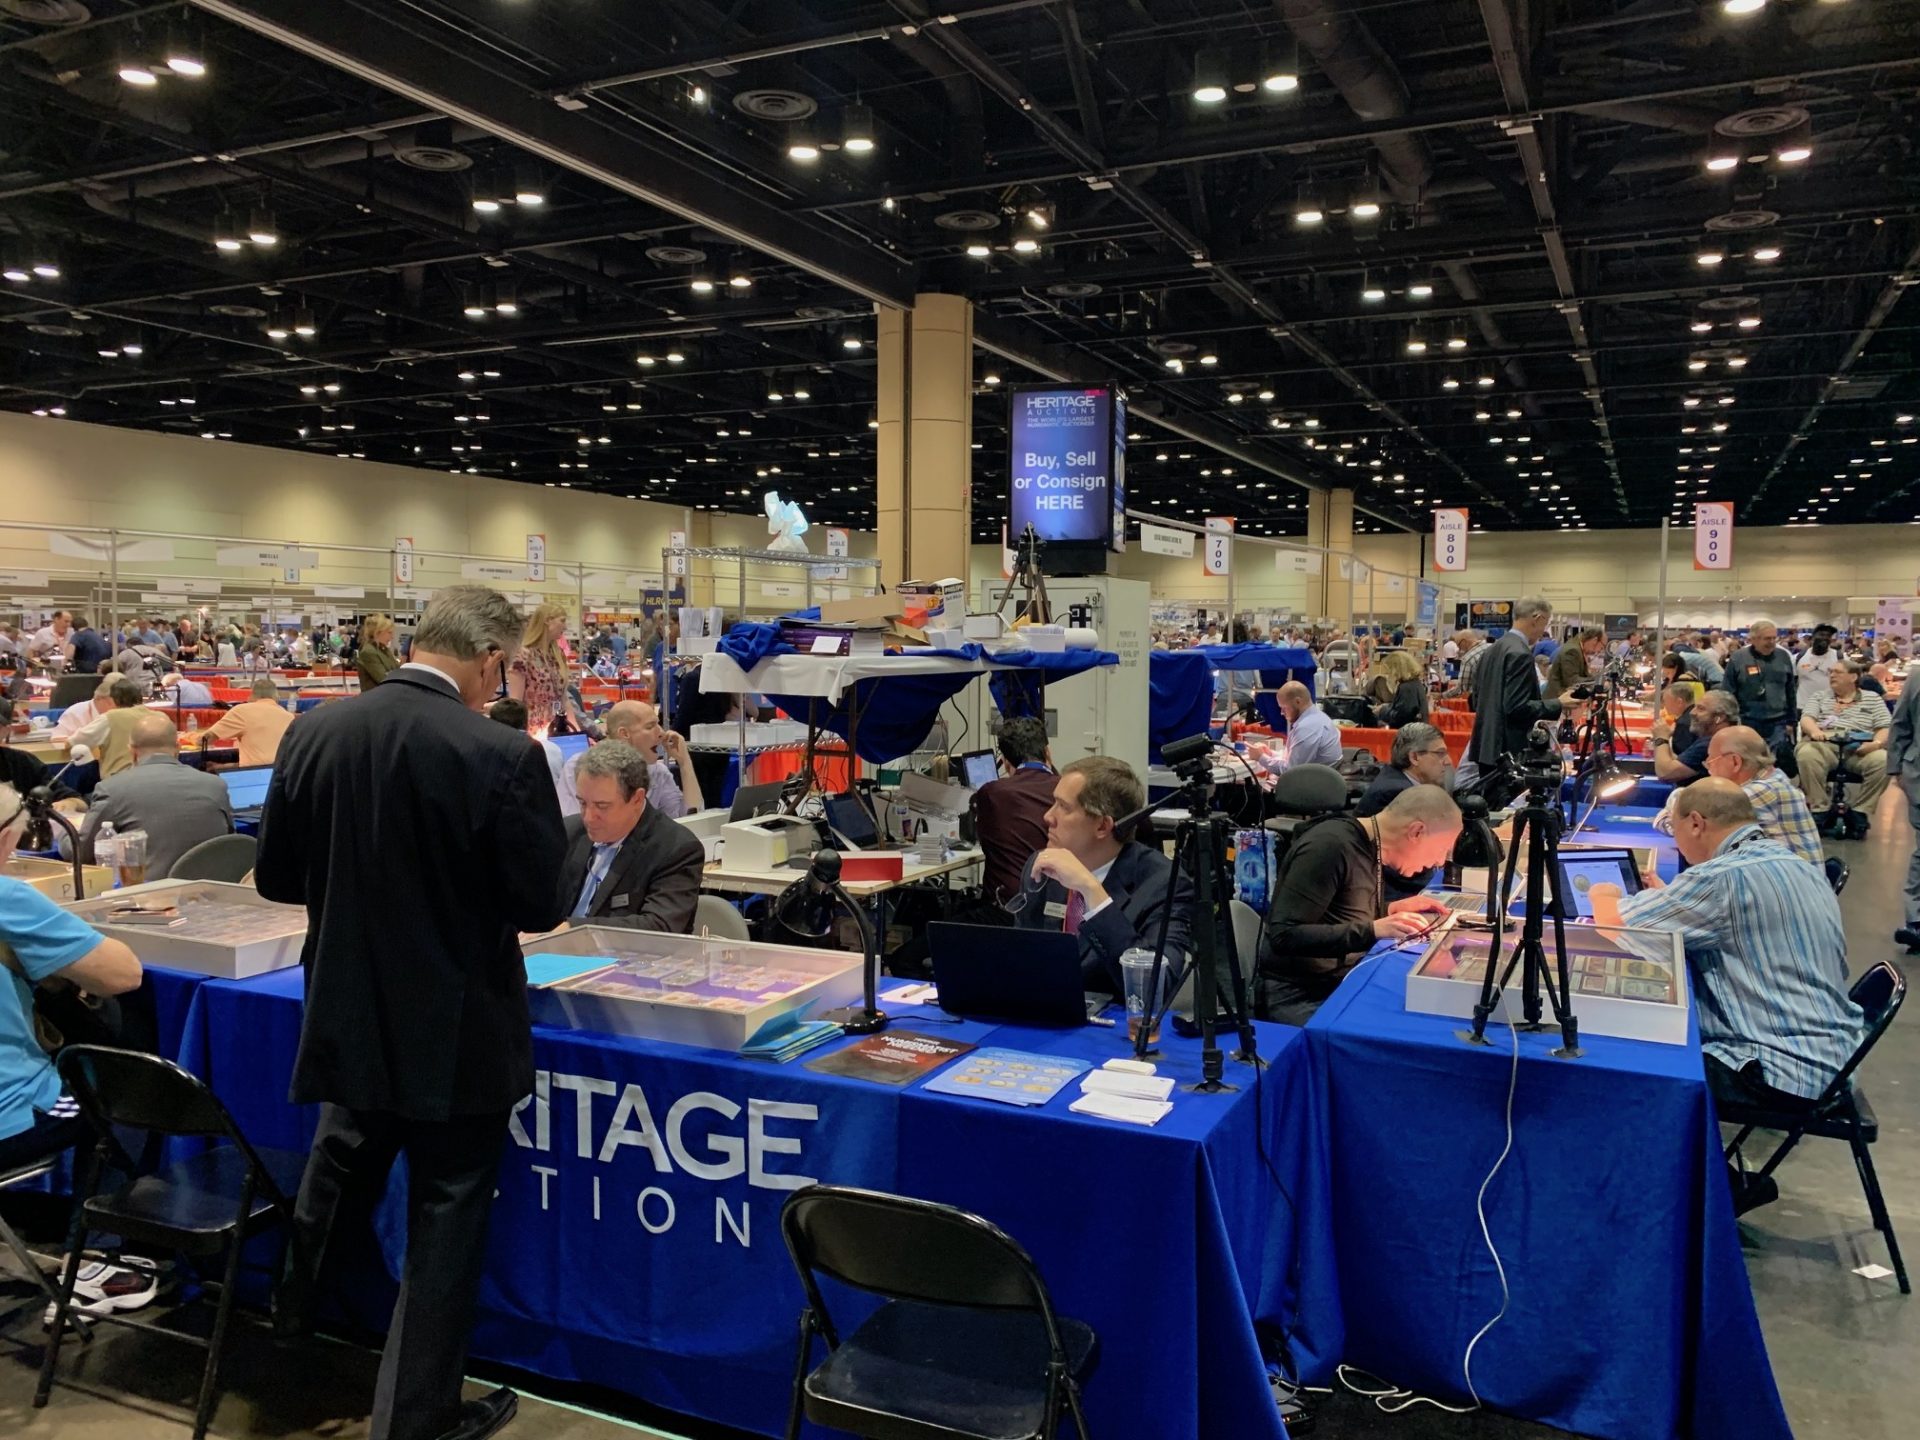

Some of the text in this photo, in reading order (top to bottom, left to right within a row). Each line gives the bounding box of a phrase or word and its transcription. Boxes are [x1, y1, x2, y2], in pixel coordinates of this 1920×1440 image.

[1027, 396, 1096, 408] HERITAGE
[1025, 451, 1096, 469] Buy, Sell
[1014, 473, 1106, 491] or Consign
[1036, 495, 1084, 510] HERE
[1214, 540, 1222, 568] 700
[1446, 533, 1455, 565] 800
[1708, 529, 1718, 562] 900
